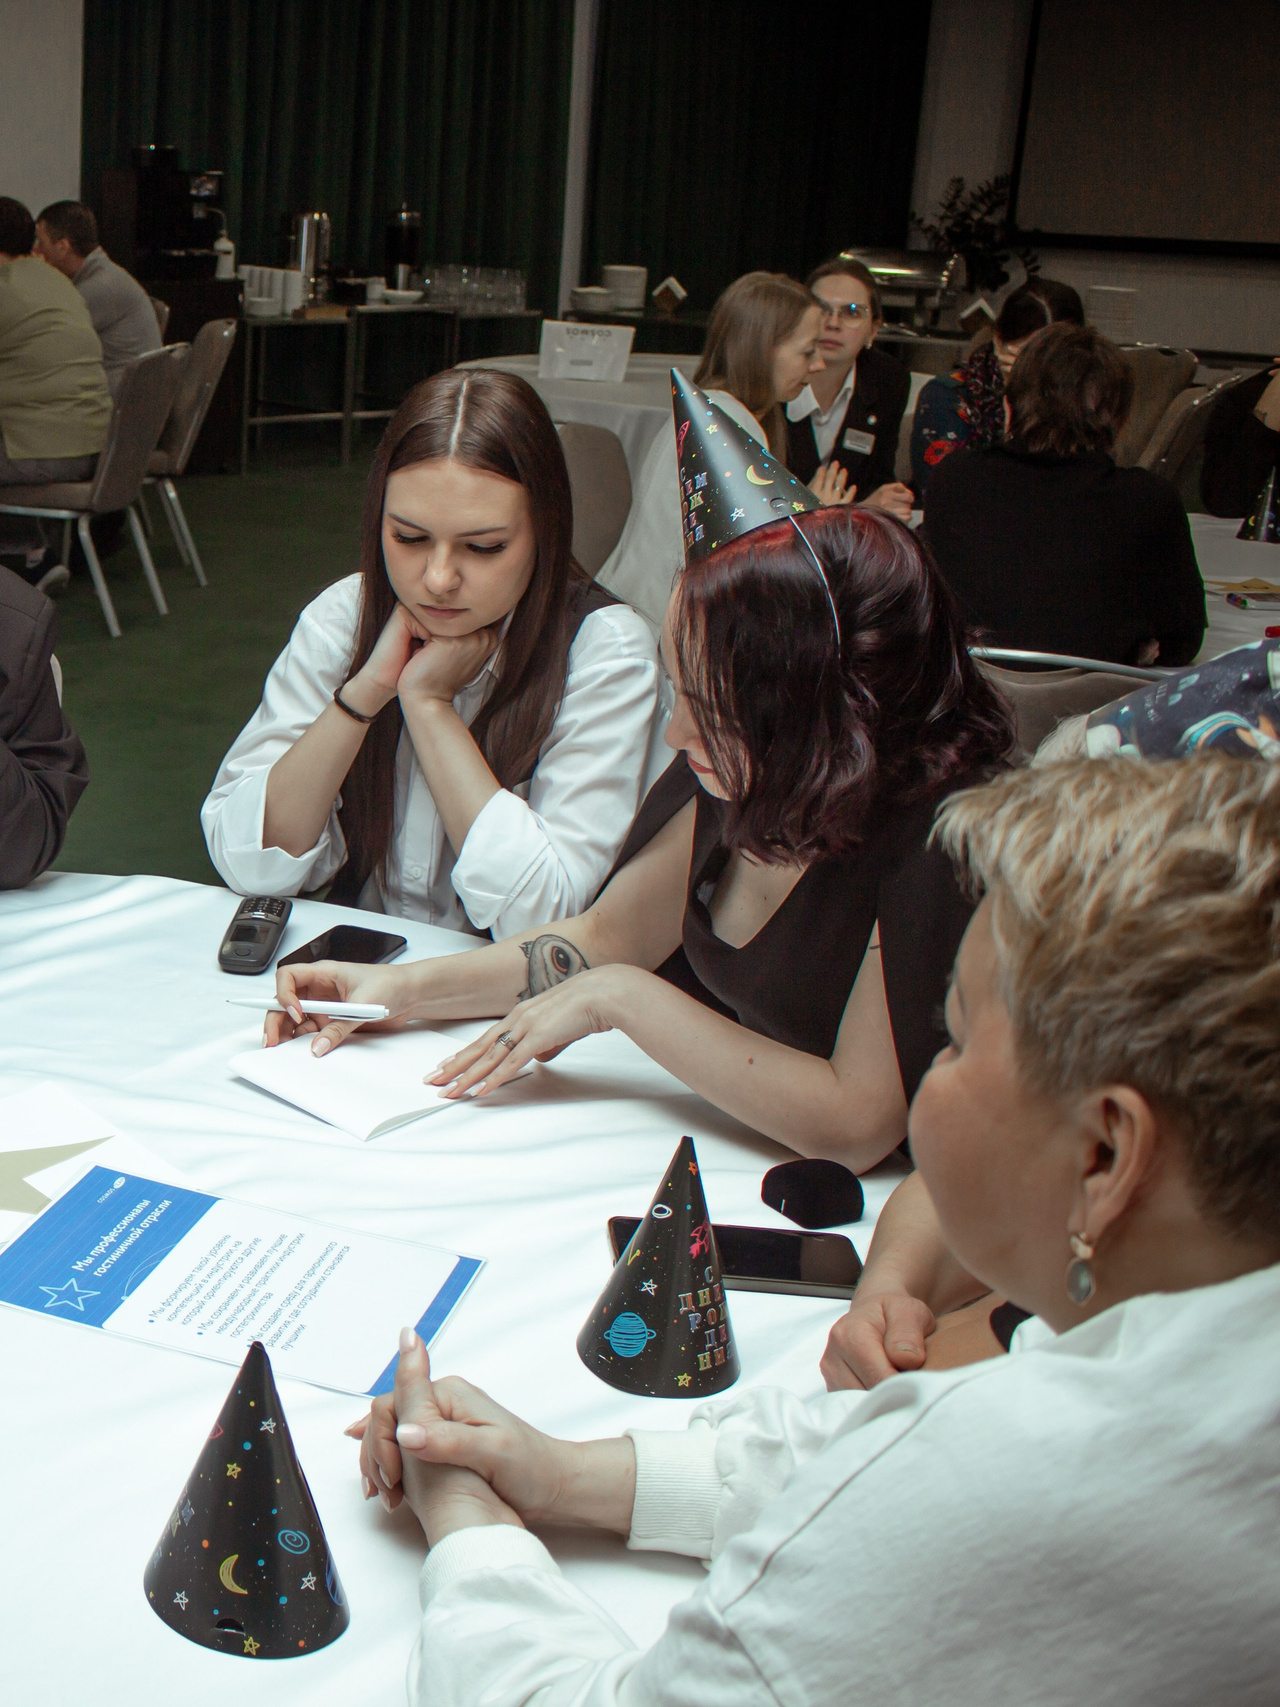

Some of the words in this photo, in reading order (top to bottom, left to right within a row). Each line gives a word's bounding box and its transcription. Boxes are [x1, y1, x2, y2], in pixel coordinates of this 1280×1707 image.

[71, 1256, 94, 1271] Мы
[89, 1199, 150, 1256] профессионалы
[93, 1227, 144, 1276] гостиничной
[139, 1199, 172, 1228] отрасли
[704, 1265, 714, 1283] С
[148, 1306, 165, 1318] Мы
[160, 1273, 195, 1307] формируем
[191, 1256, 210, 1273] такой
[207, 1234, 231, 1257] уровень
[166, 1283, 204, 1321] компетенций
[205, 1248, 238, 1279] индустрии,
[232, 1240, 242, 1248] на
[180, 1300, 206, 1325] который
[203, 1256, 245, 1300] ориентируются
[241, 1237, 261, 1257] другие
[197, 1319, 214, 1330] Мы
[210, 1288, 241, 1319] сохраняем
[241, 1254, 270, 1284] развиваем
[266, 1233, 288, 1254] лучшие
[215, 1287, 259, 1334] международные
[254, 1261, 281, 1288] практики
[277, 1232, 304, 1262] индустрии
[229, 1292, 273, 1338] гостеприимства
[259, 1307, 284, 1332] создаем
[280, 1290, 300, 1307] среду
[294, 1279, 307, 1291] для
[302, 1241, 337, 1279] гармоничного
[265, 1319, 294, 1347] развития,
[288, 1309, 301, 1319] где
[296, 1275, 327, 1308] сотрудники
[322, 1245, 350, 1275] становятся
[280, 1323, 306, 1351] лучшими
[704, 1323, 727, 1351] ДЕ
